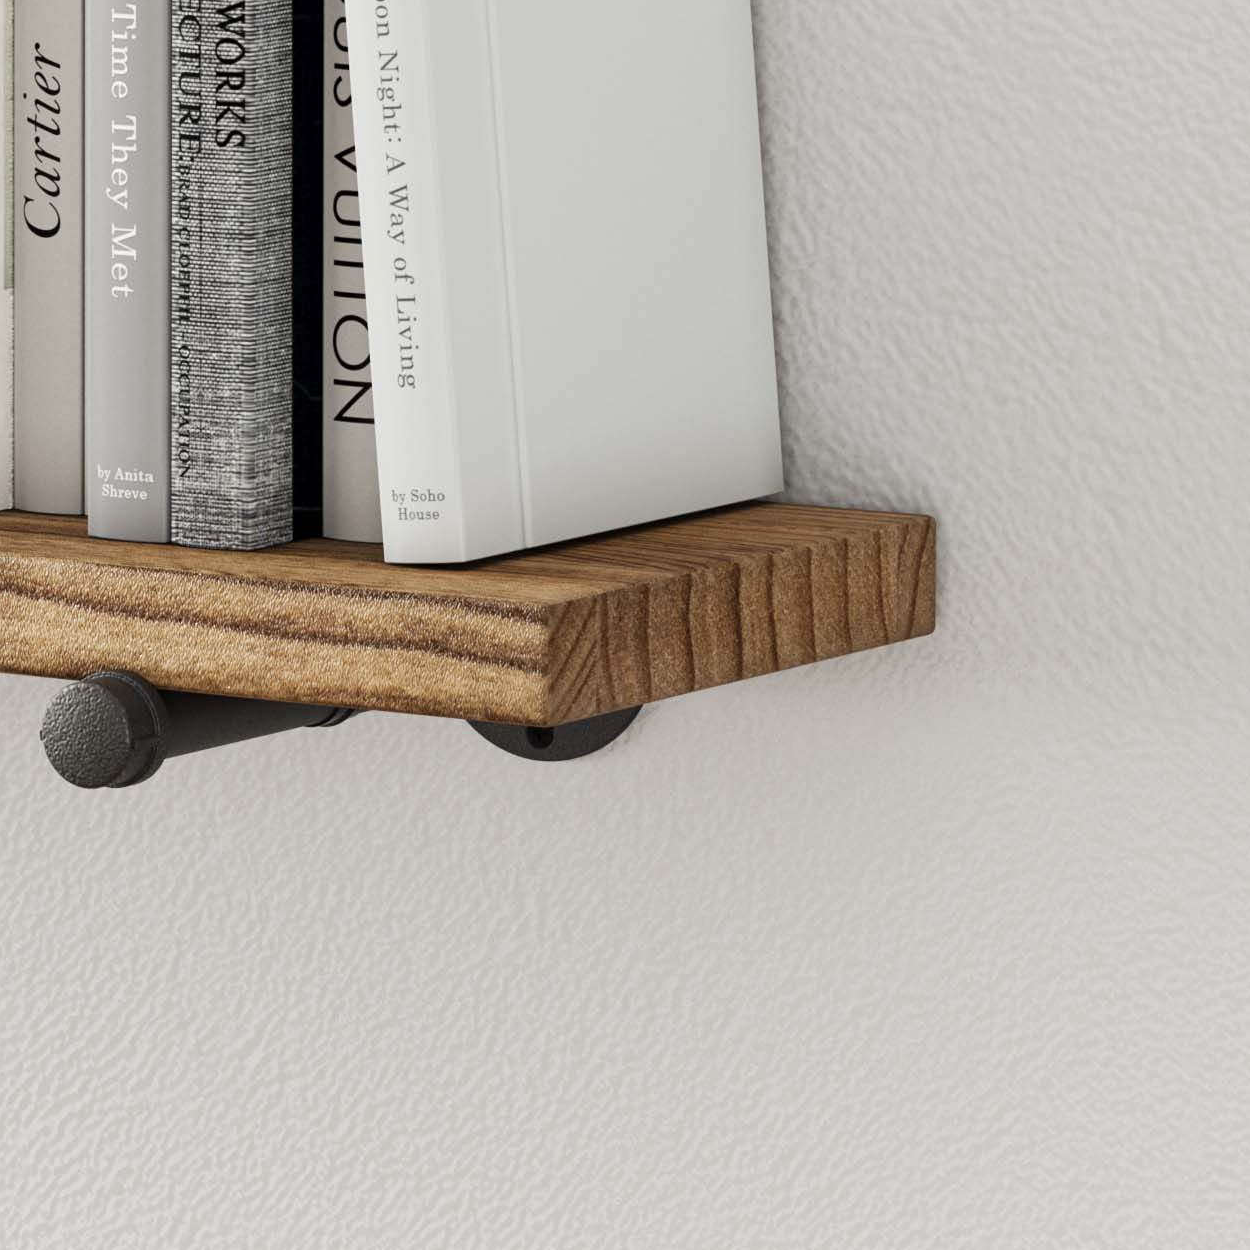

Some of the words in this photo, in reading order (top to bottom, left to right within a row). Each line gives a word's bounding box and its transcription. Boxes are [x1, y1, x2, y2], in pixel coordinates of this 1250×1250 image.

[110, 3, 137, 99] Time
[215, 0, 245, 147] WORKS
[376, 50, 402, 143] Night:
[23, 42, 61, 238] Cartier
[105, 114, 137, 210] They
[385, 152, 407, 175] A
[386, 184, 410, 246] Way
[110, 223, 137, 299] Met
[392, 256, 417, 286] of
[395, 293, 421, 390] Living
[179, 345, 191, 478] OCCUPATION
[97, 464, 111, 483] by
[113, 466, 154, 483] Anita
[101, 483, 148, 501] Shreve
[391, 489, 406, 505] by
[410, 488, 446, 503] Soho
[398, 506, 440, 521] House
